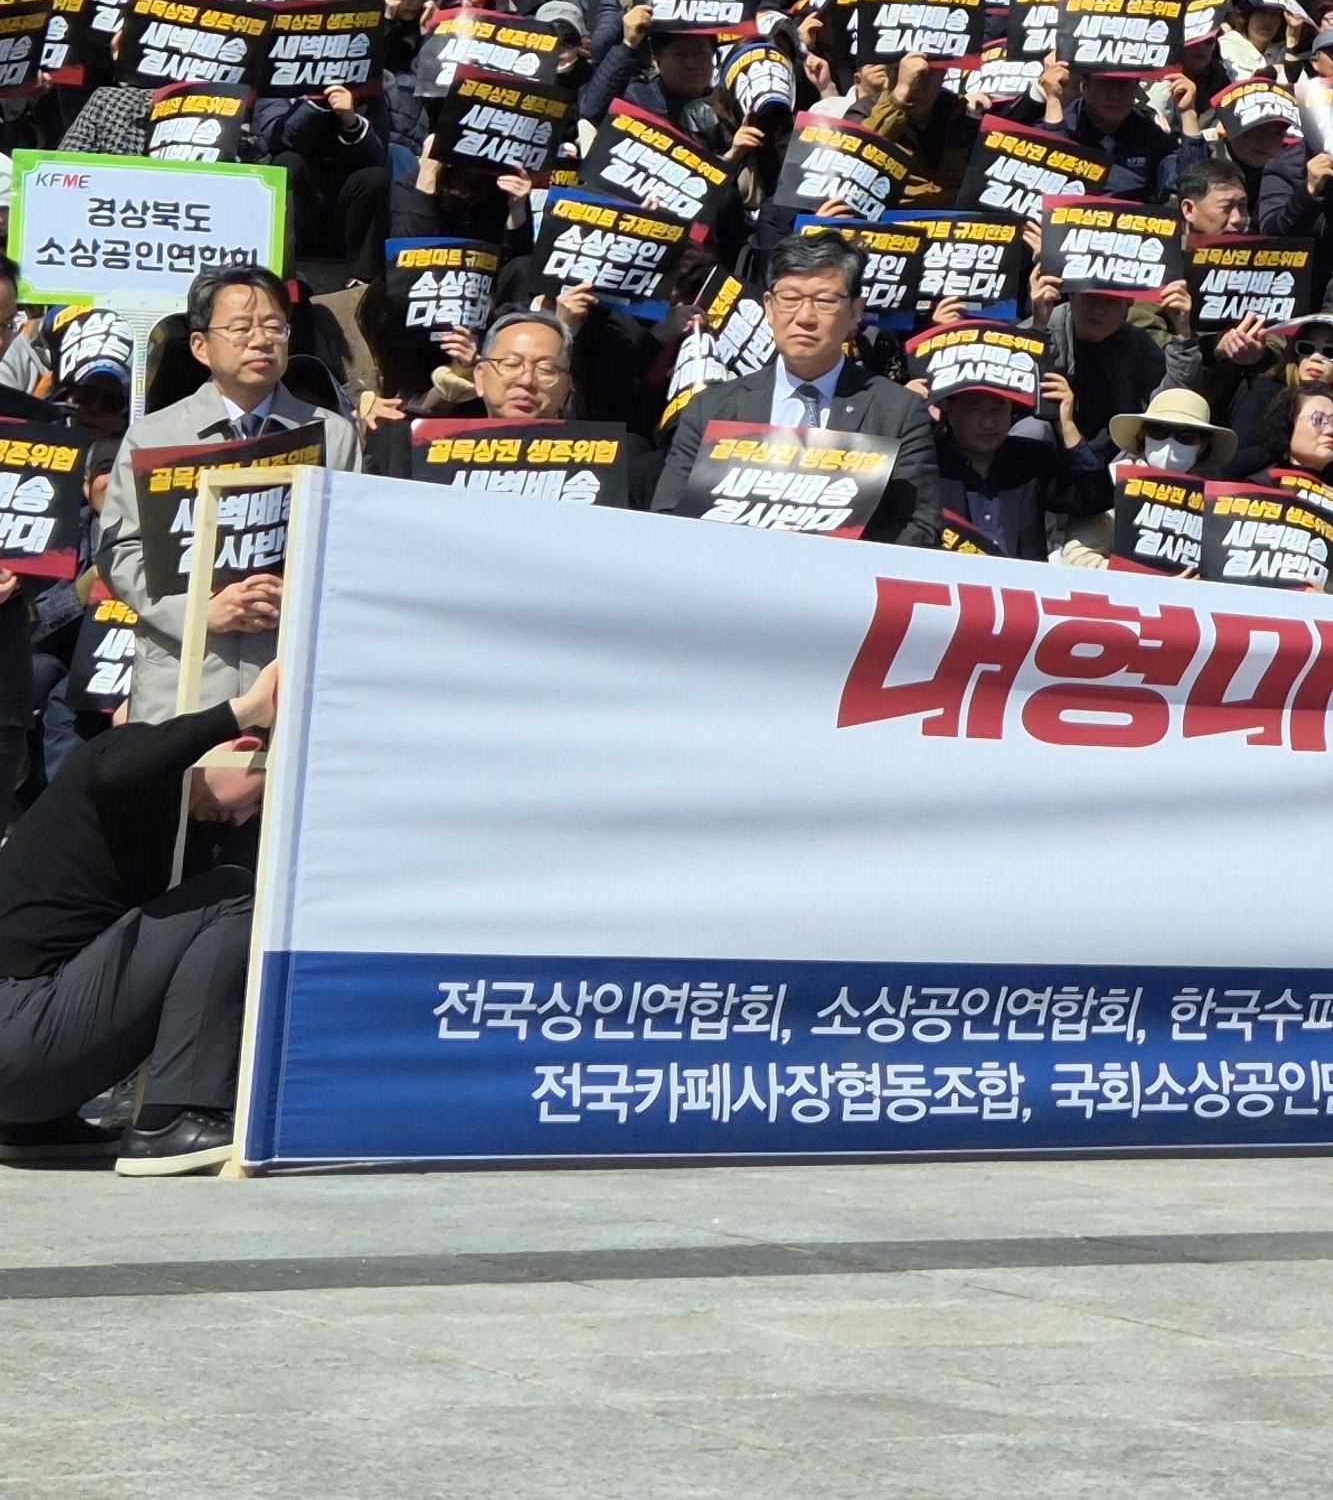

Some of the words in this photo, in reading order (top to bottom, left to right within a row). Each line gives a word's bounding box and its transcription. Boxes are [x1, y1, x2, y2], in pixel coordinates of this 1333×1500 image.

[649, 0, 744, 23] 결사반대
[873, 4, 970, 31] 새벽배송
[1072, 15, 1169, 42] 새벽배송
[138, 21, 248, 62] 새벽배송
[874, 28, 971, 57] 결사반대
[1074, 39, 1170, 67] 결사반대
[137, 47, 246, 84] 결사반대
[459, 105, 552, 145] 새벽배송
[454, 130, 548, 171] 결사반대
[609, 138, 708, 198] 새벽배송
[35, 172, 91, 190] KFME
[600, 157, 704, 219] 결사반대
[87, 197, 212, 233] 경상북도
[552, 224, 667, 269] 소상공인
[1059, 228, 1164, 262] 새벽배송
[541, 250, 664, 298] 다죽는다!
[1061, 254, 1166, 288] 결사반대
[1199, 269, 1295, 295] 새벽배송
[1199, 295, 1295, 321] 결사반대
[426, 440, 521, 462] 골목상권
[526, 440, 619, 464] 생존위협
[709, 440, 798, 466] 골목상권
[801, 448, 889, 472] 생존위협
[452, 470, 601, 503] 새벽배송
[711, 467, 859, 506] 새벽배송
[701, 498, 854, 531] 결사반대
[1222, 520, 1328, 562] 새벽배송
[1222, 549, 1329, 587] 결사반대
[433, 981, 792, 1045] 전국상인연합회,
[809, 984, 1147, 1045] 소상공인연합회,
[531, 1061, 1033, 1125] 전국카페사장협동조합,
